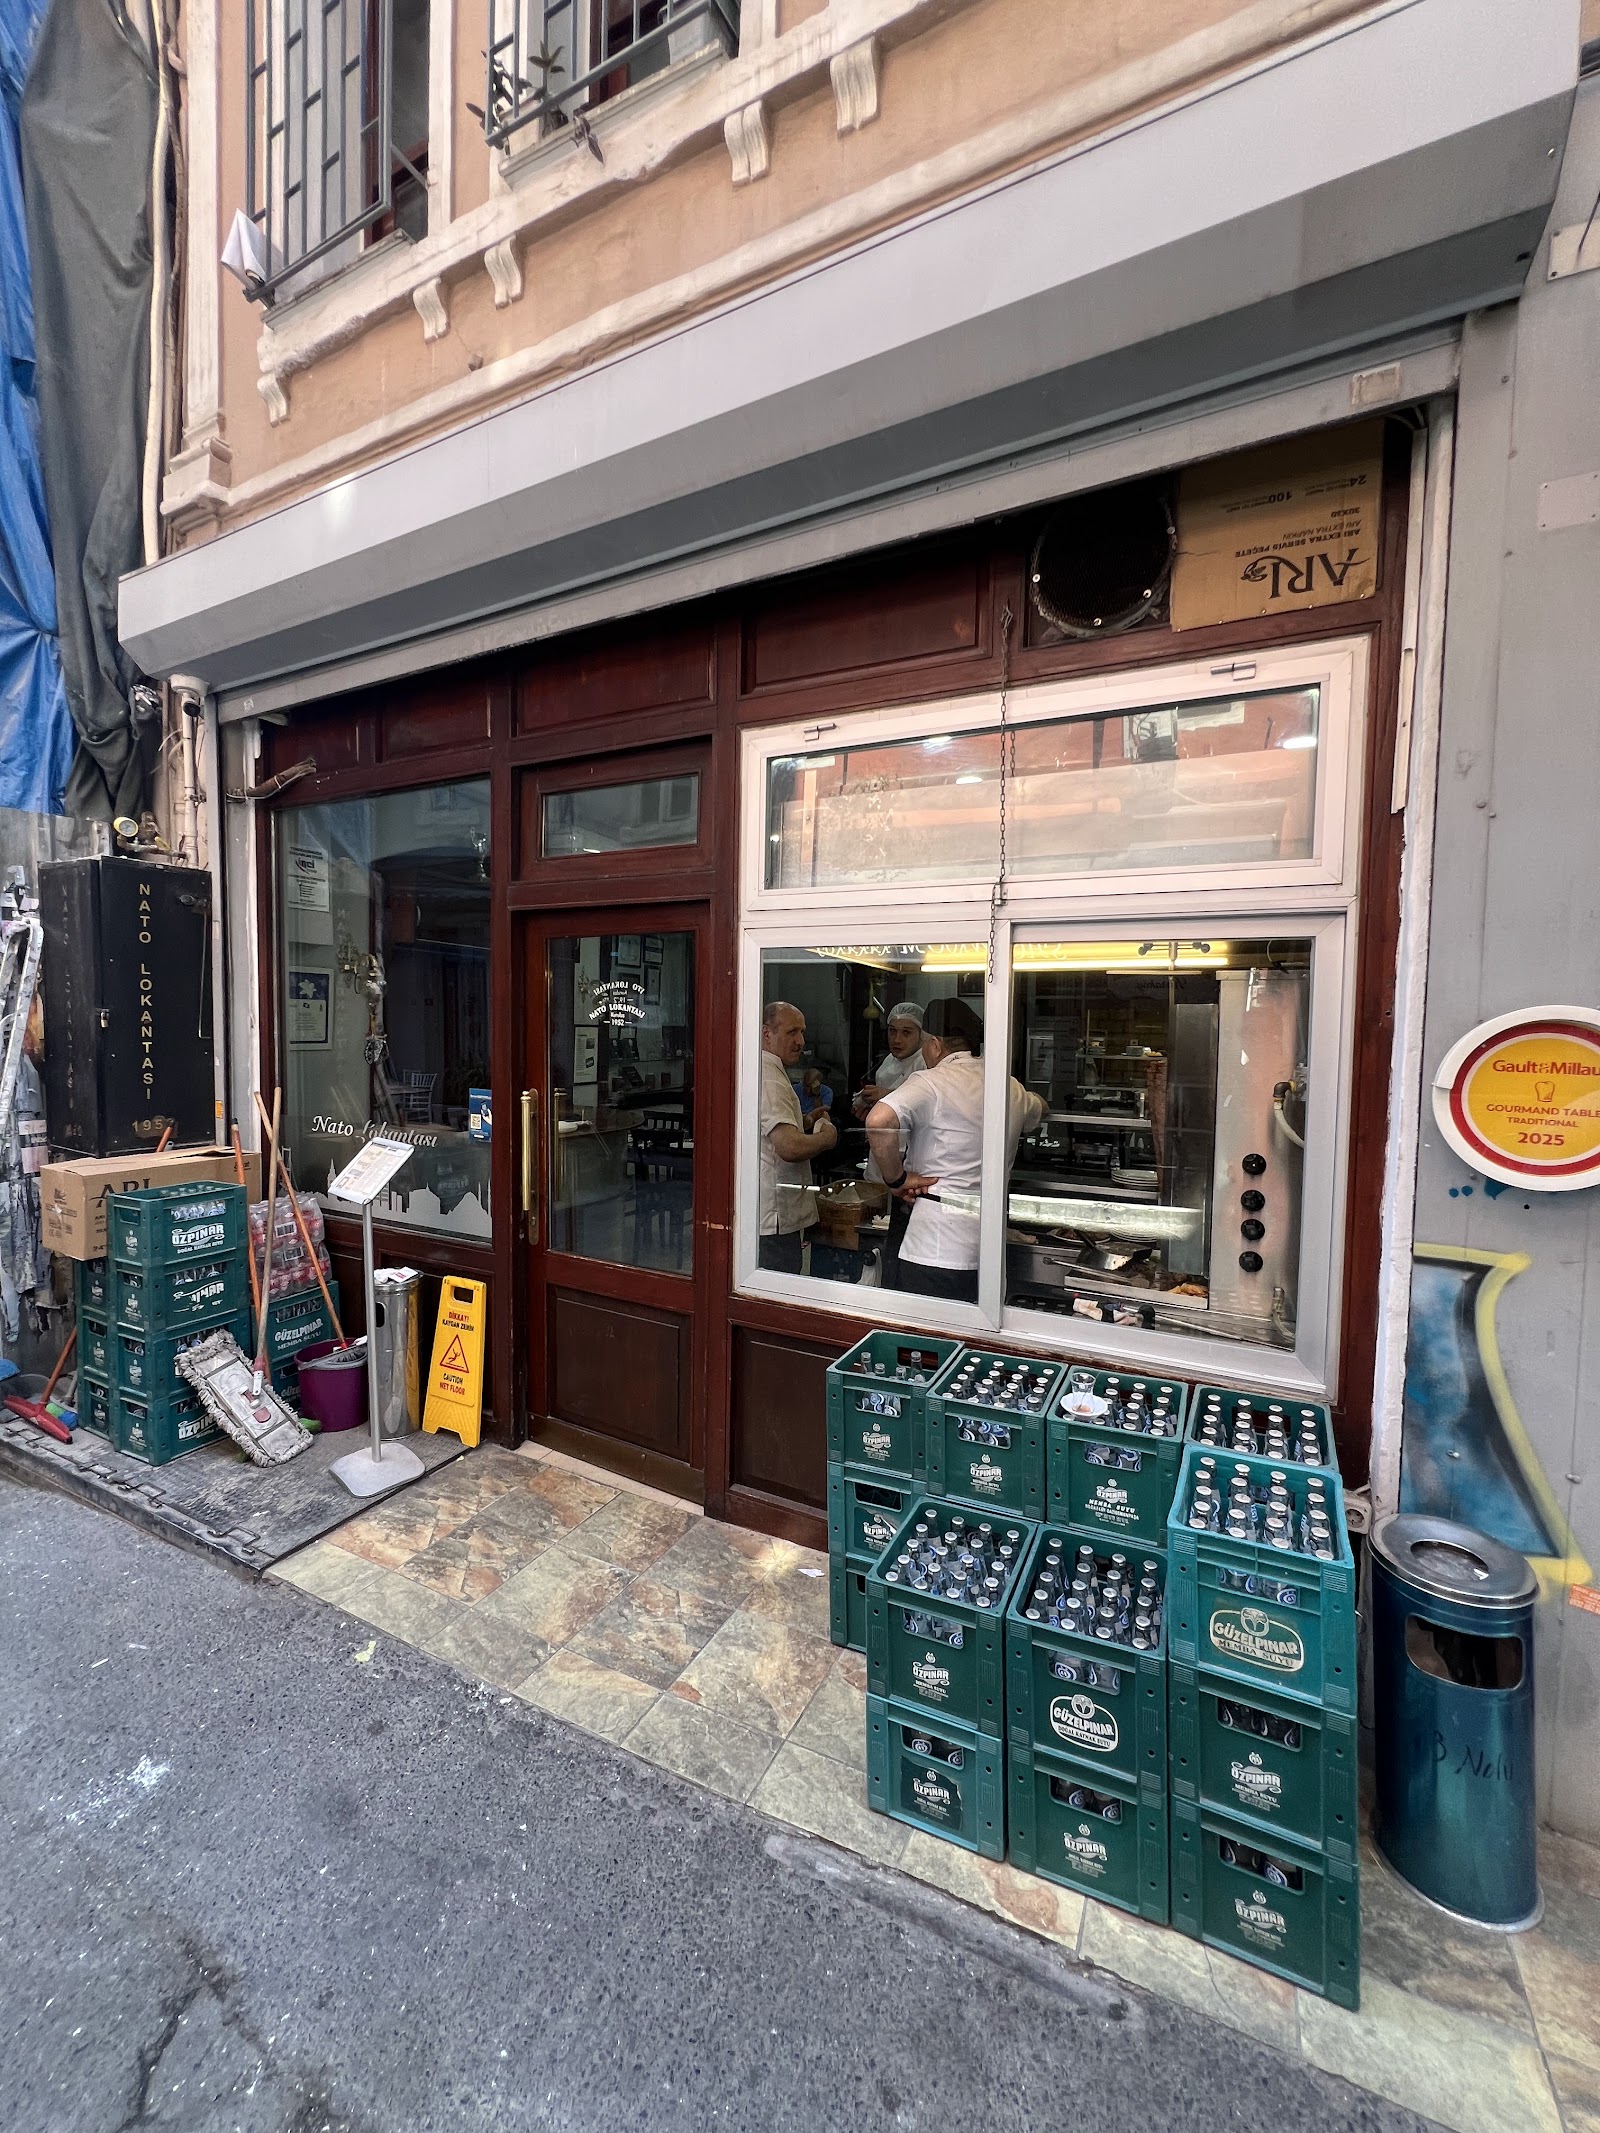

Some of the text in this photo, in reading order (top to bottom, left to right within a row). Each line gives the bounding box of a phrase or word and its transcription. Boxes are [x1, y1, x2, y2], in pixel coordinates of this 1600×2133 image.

[1268, 491, 1292, 504] 100
[1310, 532, 1341, 544] EXTRA
[1262, 548, 1370, 599] ARI
[138, 884, 154, 1100] NATO LOKANTASI
[588, 1003, 646, 1020] NATO LOKANTASI
[1486, 1103, 1600, 1118] GOURMAND TABLE
[311, 1115, 354, 1137] Nato
[1507, 1116, 1578, 1128] TRADITIONAL
[1517, 1132, 1565, 1146] 2025
[274, 1318, 323, 1342] GÜZELPINAR
[443, 1373, 463, 1385] CAUTION
[1214, 1622, 1298, 1655] GÜZELPINAR
[1218, 1639, 1294, 1666] MEMBA SUYU
[1053, 1706, 1114, 1736] GÜZELPINAR
